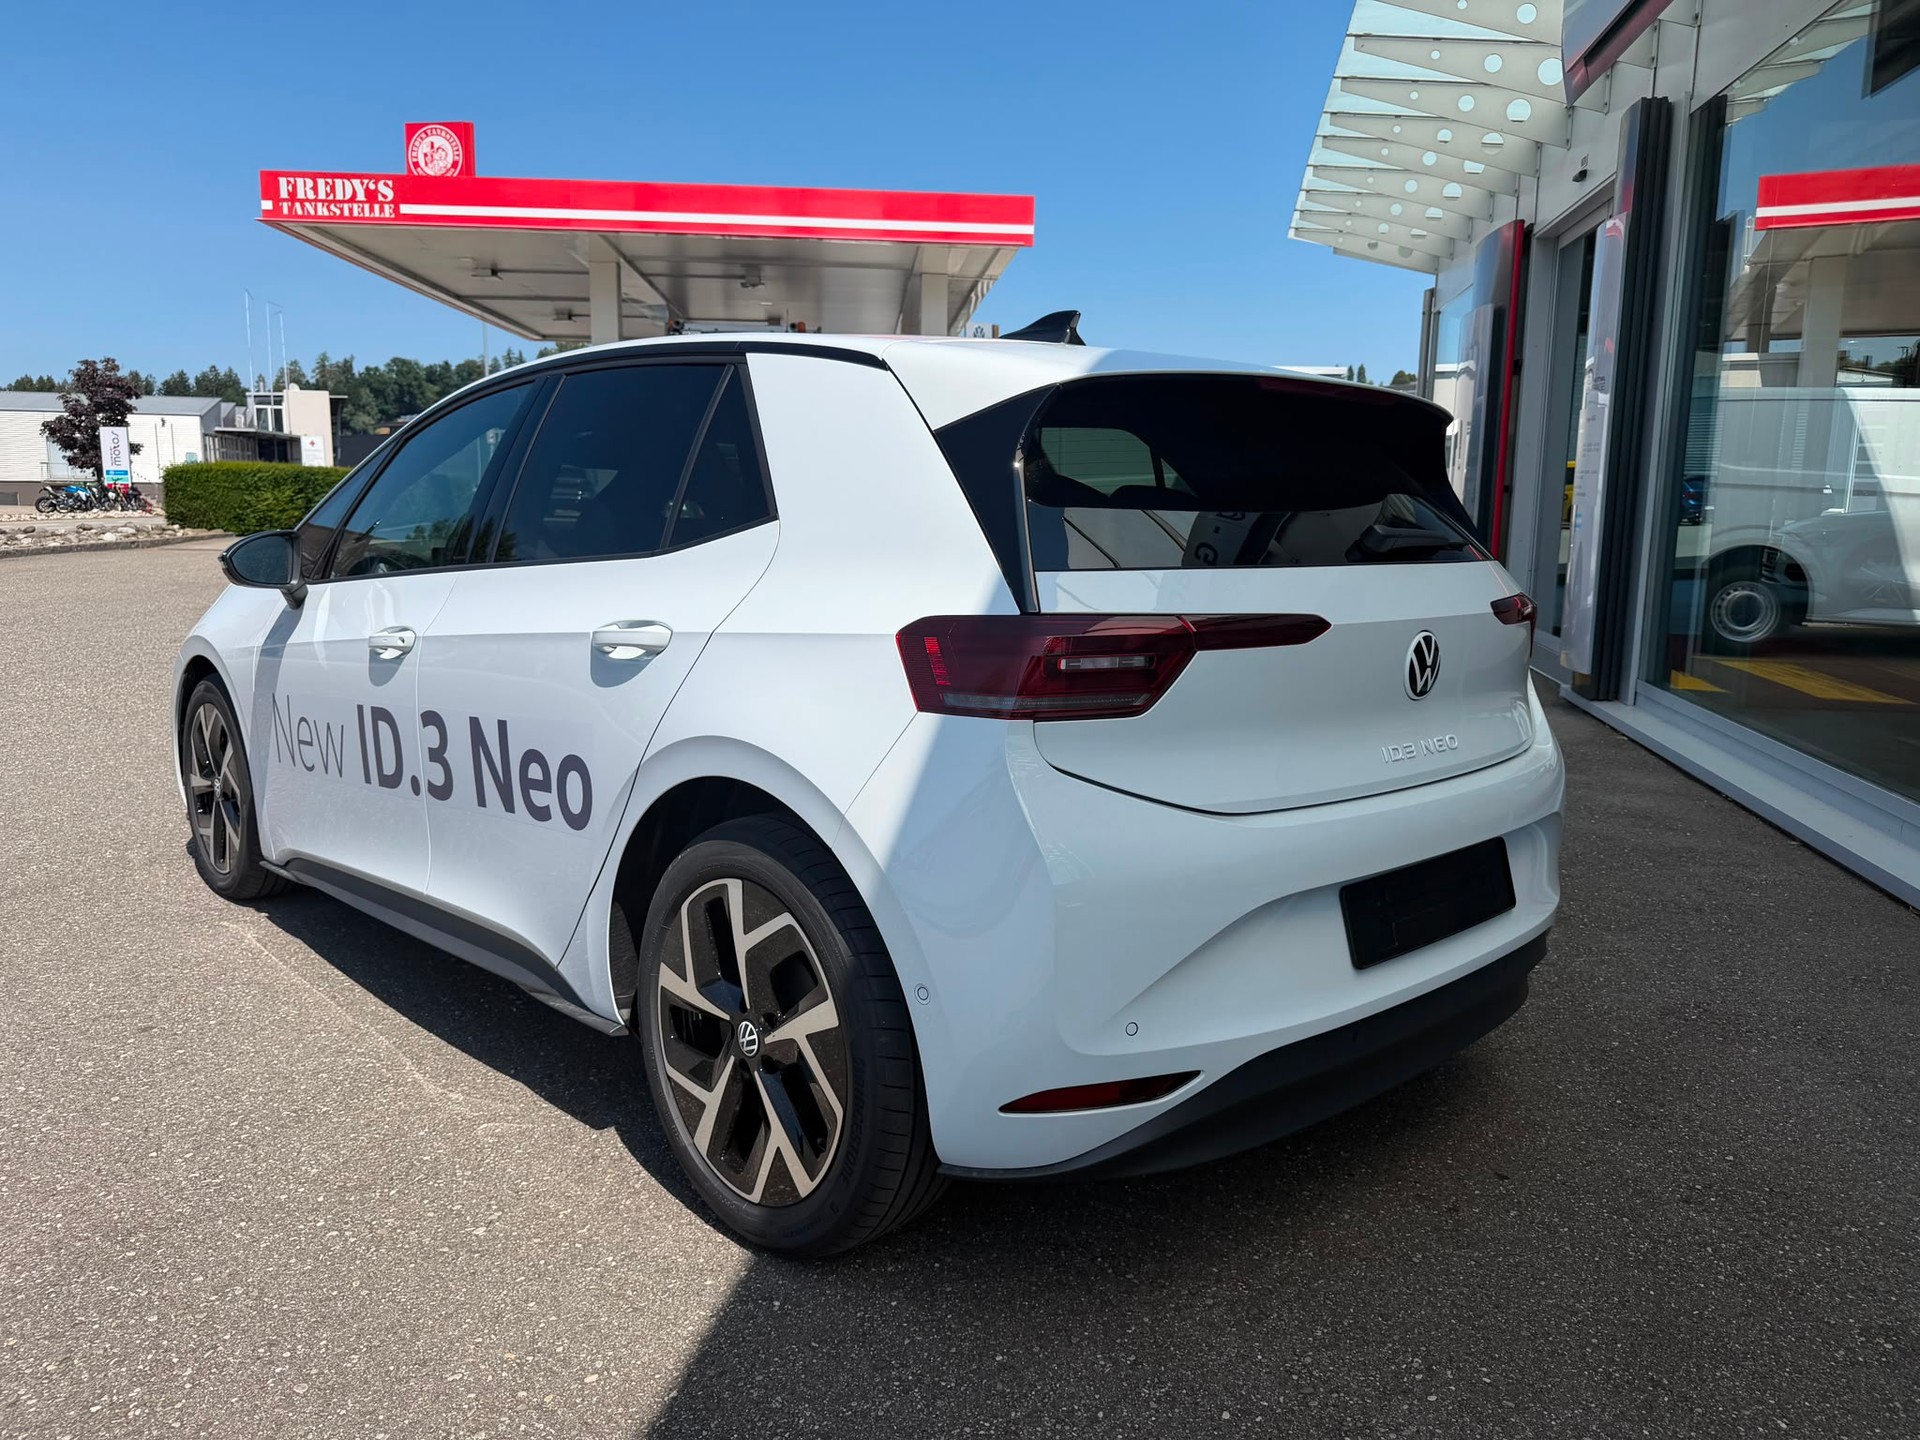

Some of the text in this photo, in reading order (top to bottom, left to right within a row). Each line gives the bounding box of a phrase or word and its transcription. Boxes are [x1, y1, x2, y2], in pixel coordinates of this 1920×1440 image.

[278, 177, 394, 202] FREDY'S
[279, 201, 395, 218] TANKSTELLE
[272, 693, 593, 831] New ID.3 Neo
[1381, 734, 1458, 763] ID.3 NEO
